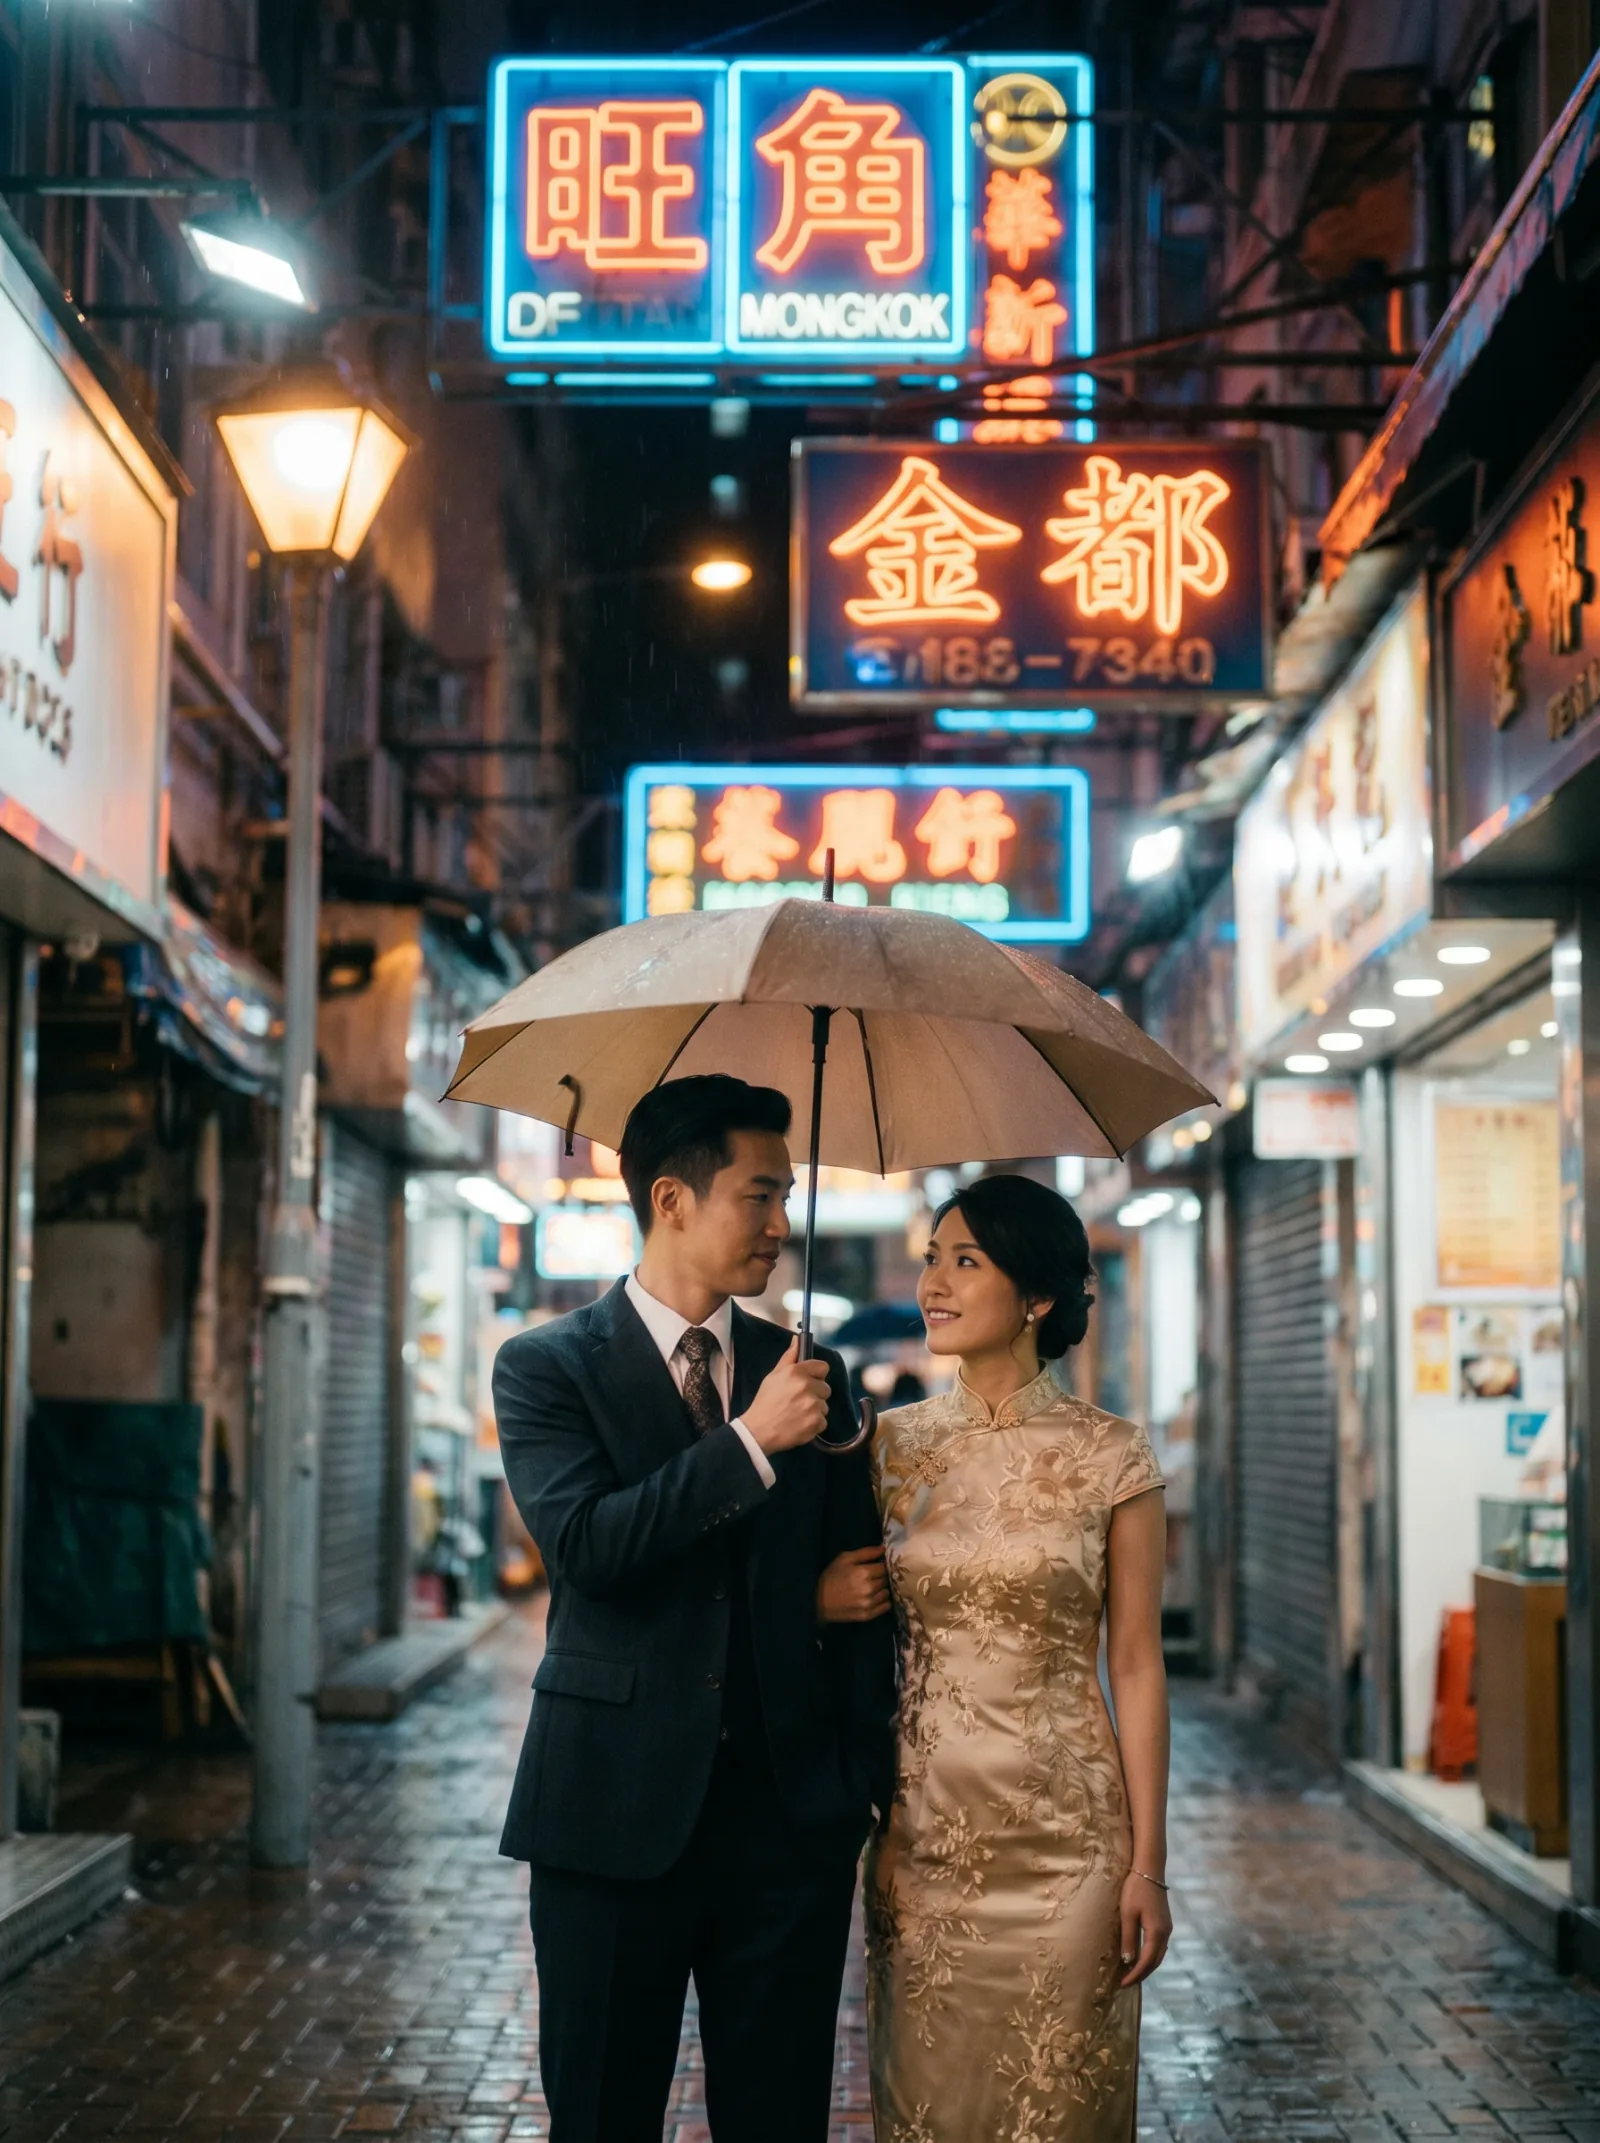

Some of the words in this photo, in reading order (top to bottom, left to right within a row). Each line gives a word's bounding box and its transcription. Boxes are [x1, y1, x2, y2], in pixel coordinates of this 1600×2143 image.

[525, 88, 926, 274] 旺角
[739, 292, 951, 340] MONGKOK
[828, 455, 1232, 635] 金都
